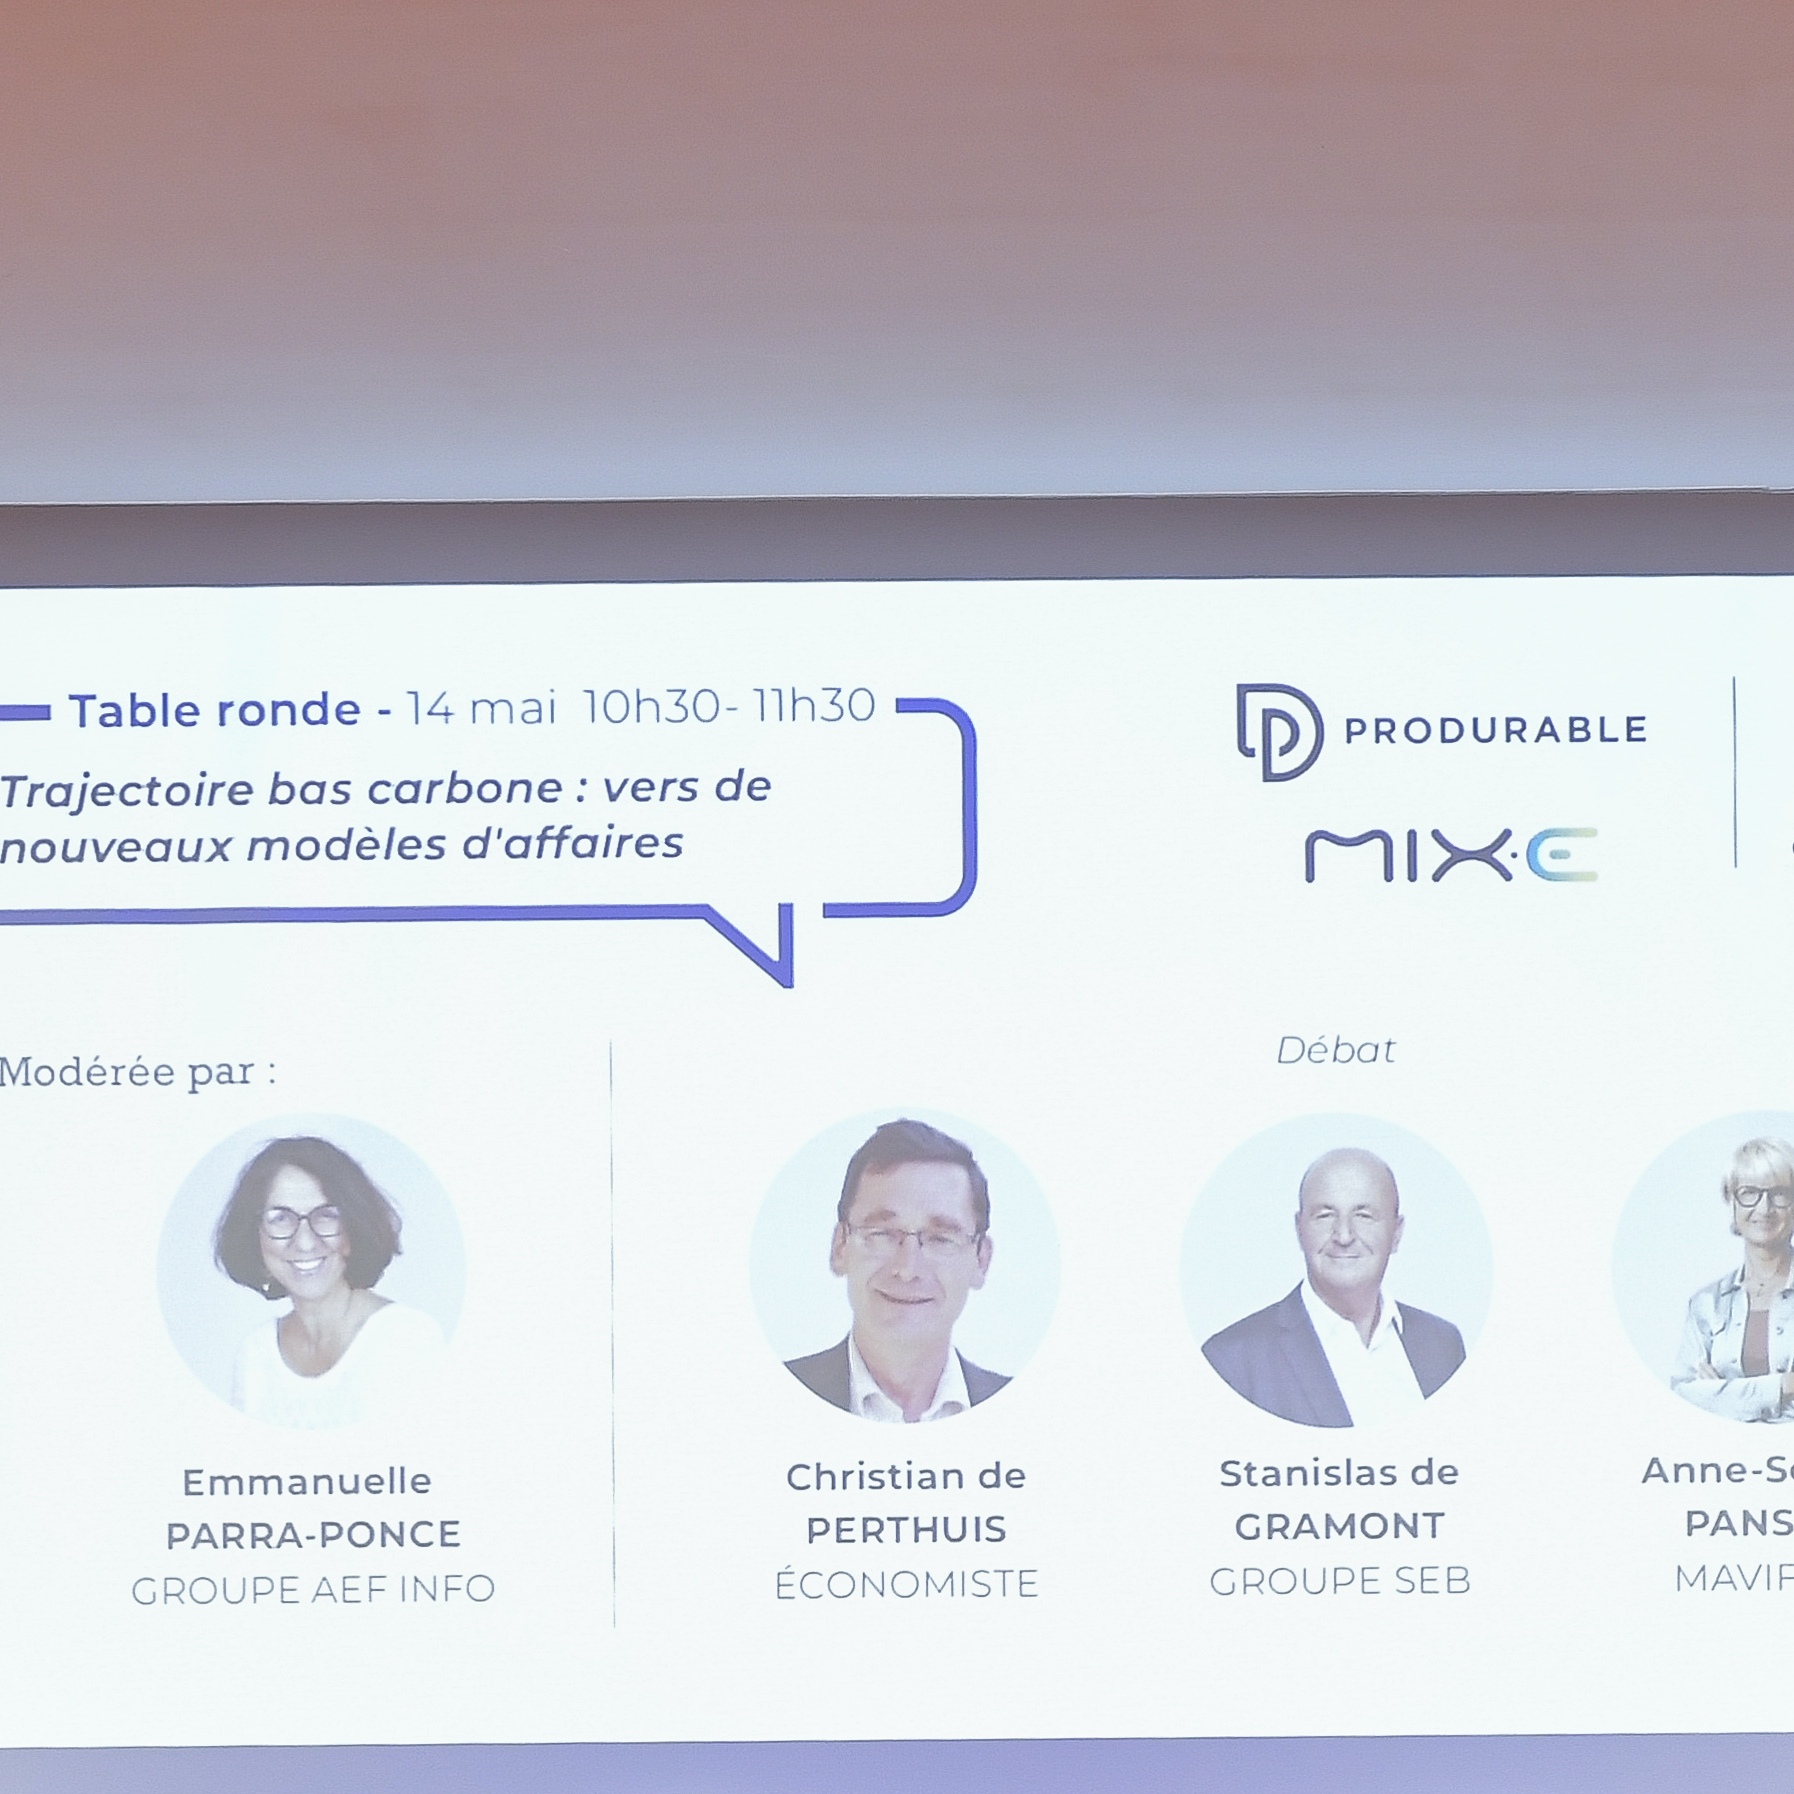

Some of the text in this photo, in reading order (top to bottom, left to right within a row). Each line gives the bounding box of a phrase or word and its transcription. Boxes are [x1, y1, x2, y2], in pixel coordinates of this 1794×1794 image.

[68, 692, 200, 728] Table
[219, 691, 360, 726] ronde
[407, 691, 454, 725] 14
[472, 689, 554, 724] mai
[753, 687, 875, 722] 11h30
[1346, 716, 1646, 744] PRODURABLE
[1, 771, 254, 814] Trajectoire
[268, 771, 351, 805] bas
[369, 770, 562, 804] carbone
[604, 778, 698, 802] vers
[716, 768, 771, 801] de
[0, 823, 683, 864] nouveaux modèles d'affaires
[1278, 1035, 1396, 1063] Débat
[188, 1063, 254, 1094] par
[184, 1466, 431, 1496] Emmanuelle
[788, 1460, 1025, 1490] Christian de
[1221, 1457, 1458, 1487] Stanislas de
[168, 1521, 460, 1550] PARRA-PONCE
[808, 1516, 1005, 1544] PERTHUIS
[1236, 1512, 1445, 1540] GRAMONT
[132, 1575, 494, 1605] GROUPE AEF INFO
[777, 1565, 1038, 1599] ÉCONOMISTE
[1211, 1566, 1470, 1595] GROUPE SEB
